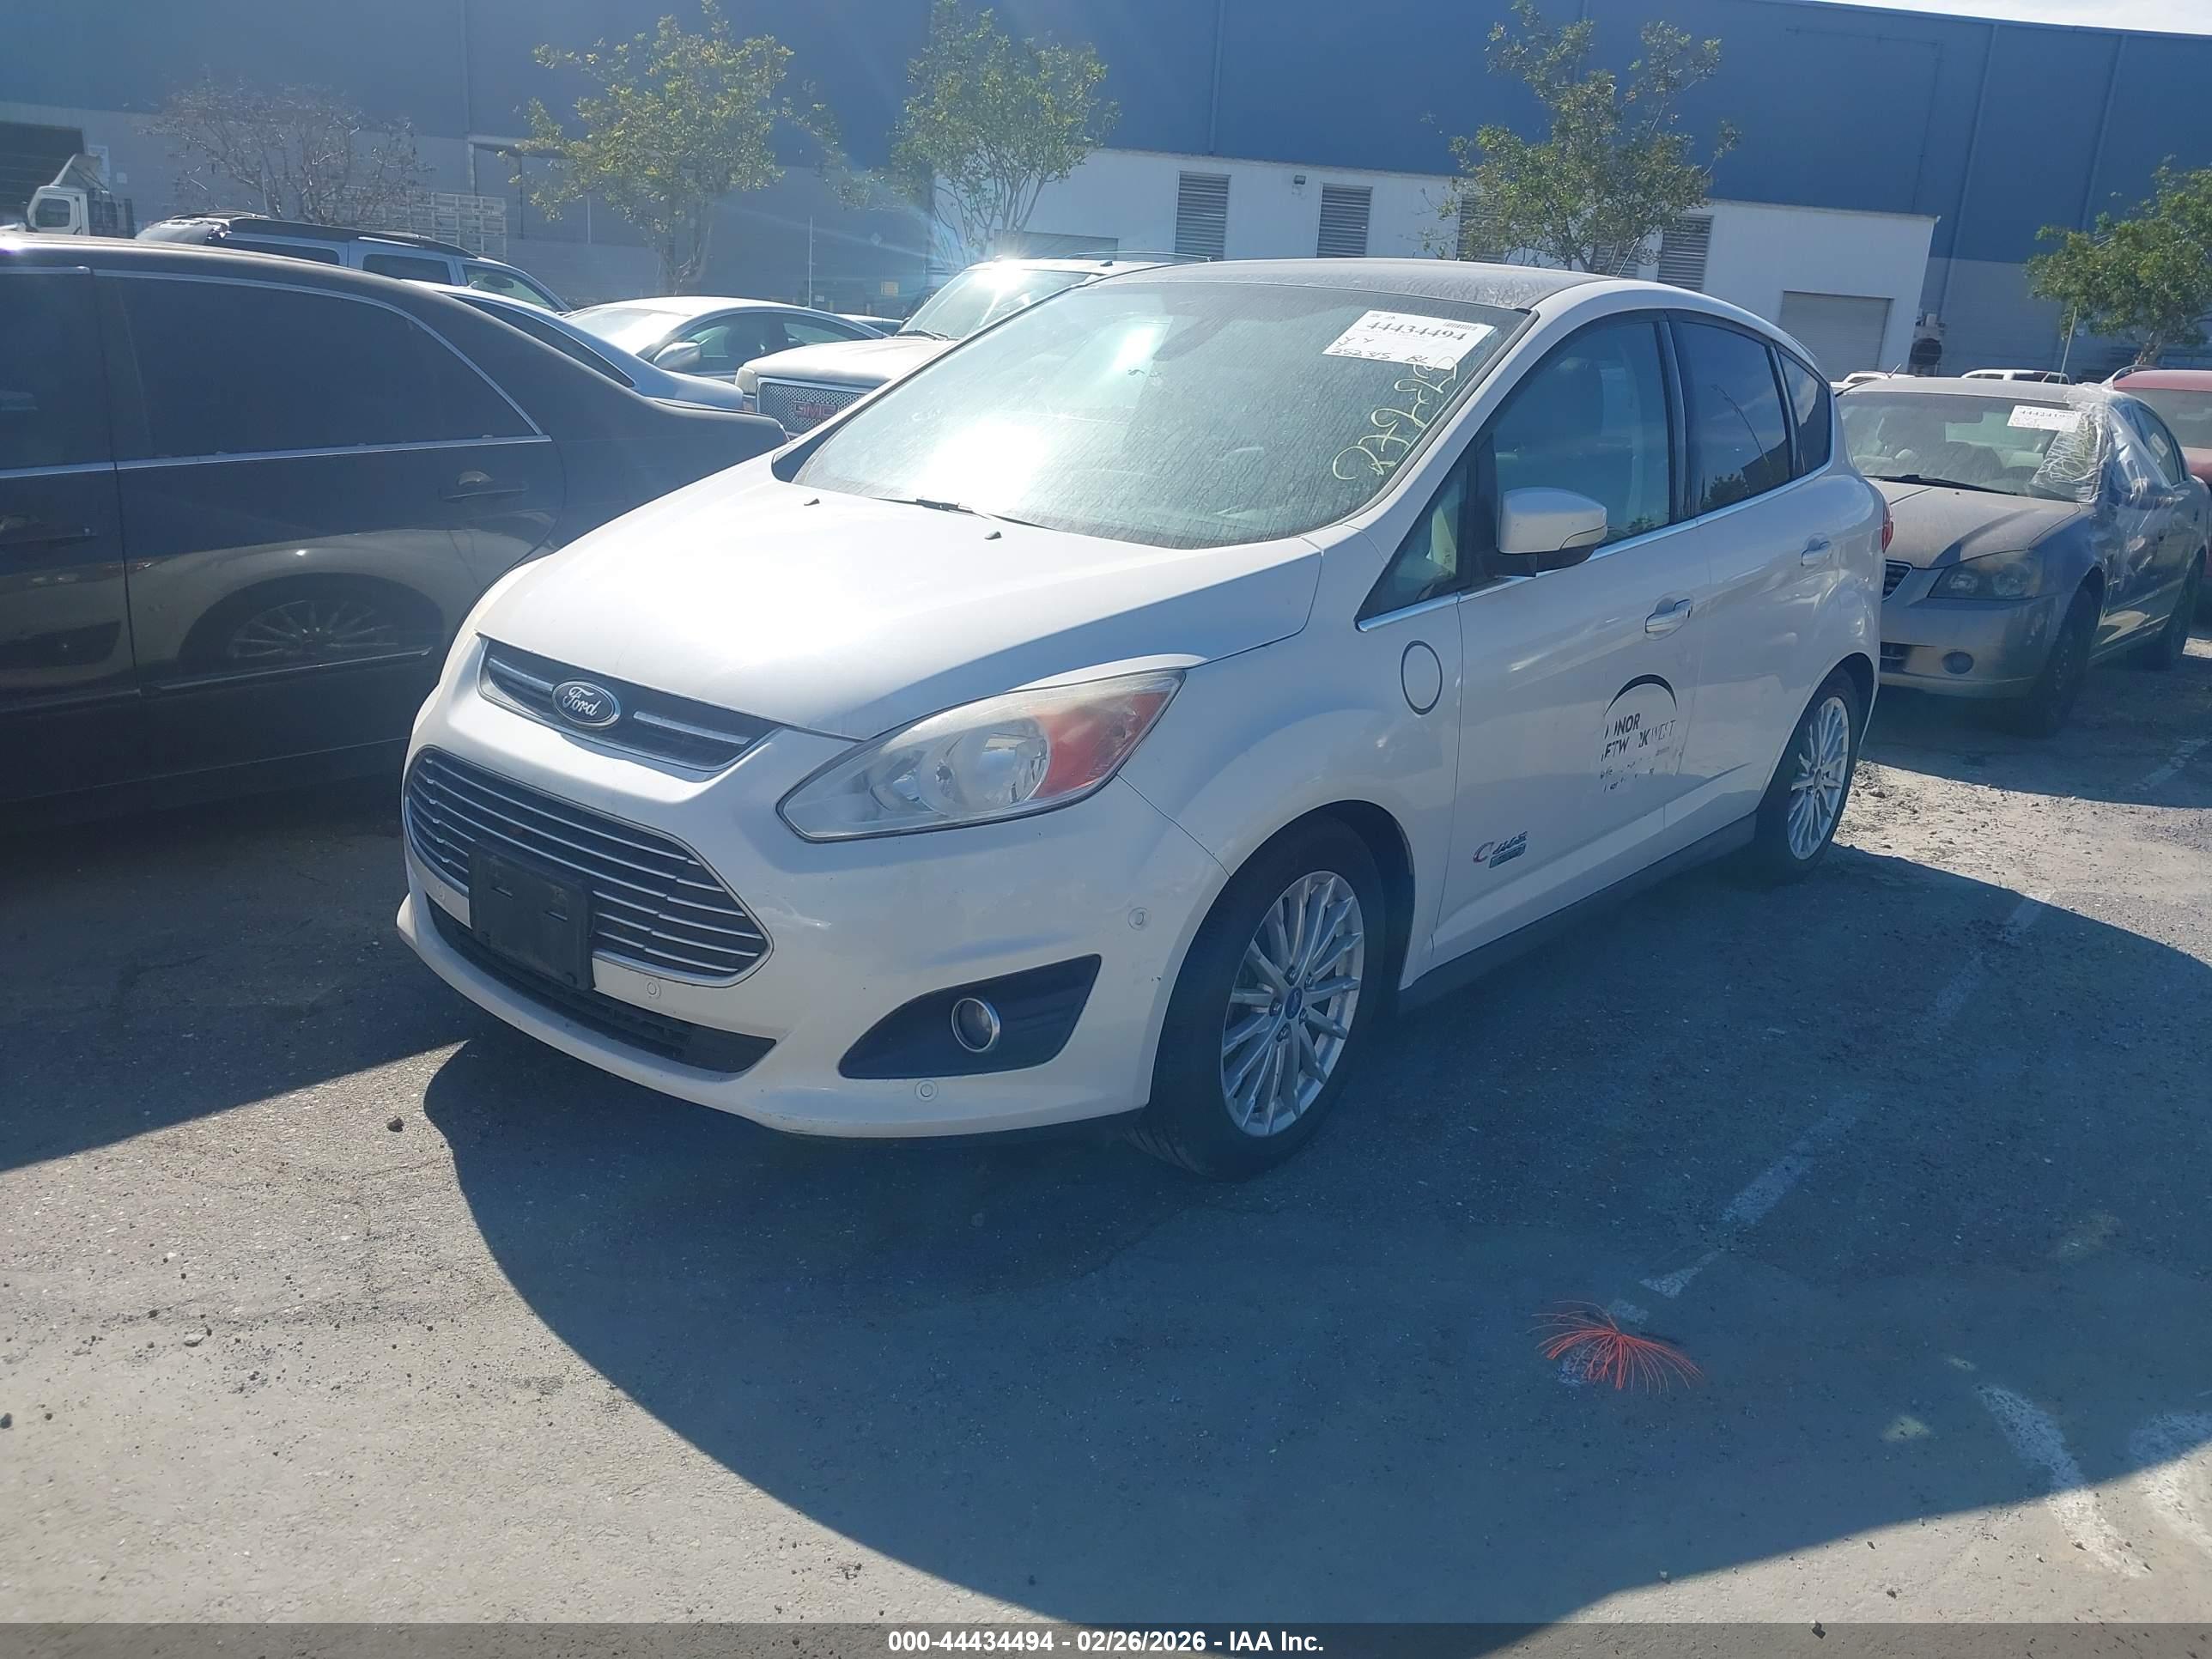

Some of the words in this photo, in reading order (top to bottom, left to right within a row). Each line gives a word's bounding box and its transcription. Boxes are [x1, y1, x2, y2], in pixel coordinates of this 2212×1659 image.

[1367, 321, 1468, 342] 44434494
[793, 400, 838, 419] GMC
[562, 686, 602, 717] Ford
